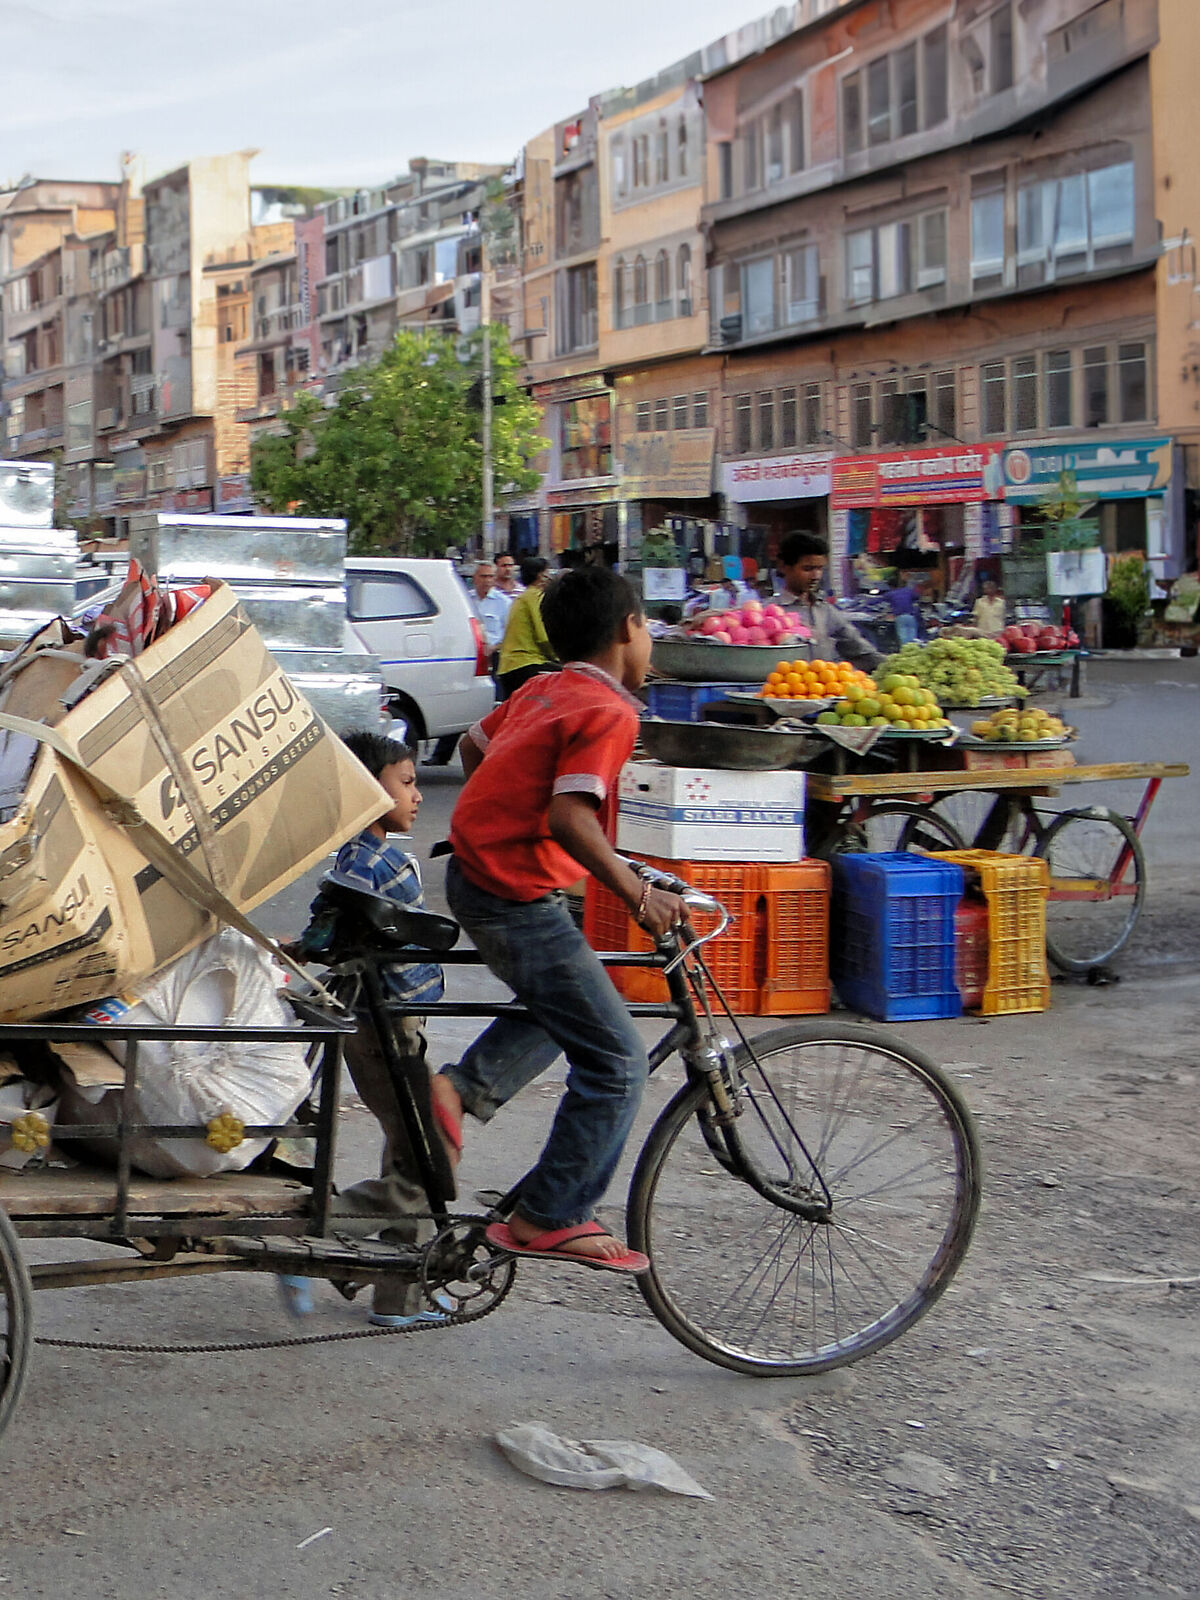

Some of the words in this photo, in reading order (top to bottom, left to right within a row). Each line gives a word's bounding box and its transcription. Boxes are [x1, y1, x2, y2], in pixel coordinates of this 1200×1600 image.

[167, 708, 311, 838] TEEVISION
[191, 675, 301, 786] SANSUI
[232, 763, 279, 809] SOUNDS
[282, 724, 321, 766] BETTER
[683, 810, 738, 822] STARR
[740, 811, 796, 824] RANCH
[1, 873, 91, 951] SANSUI
